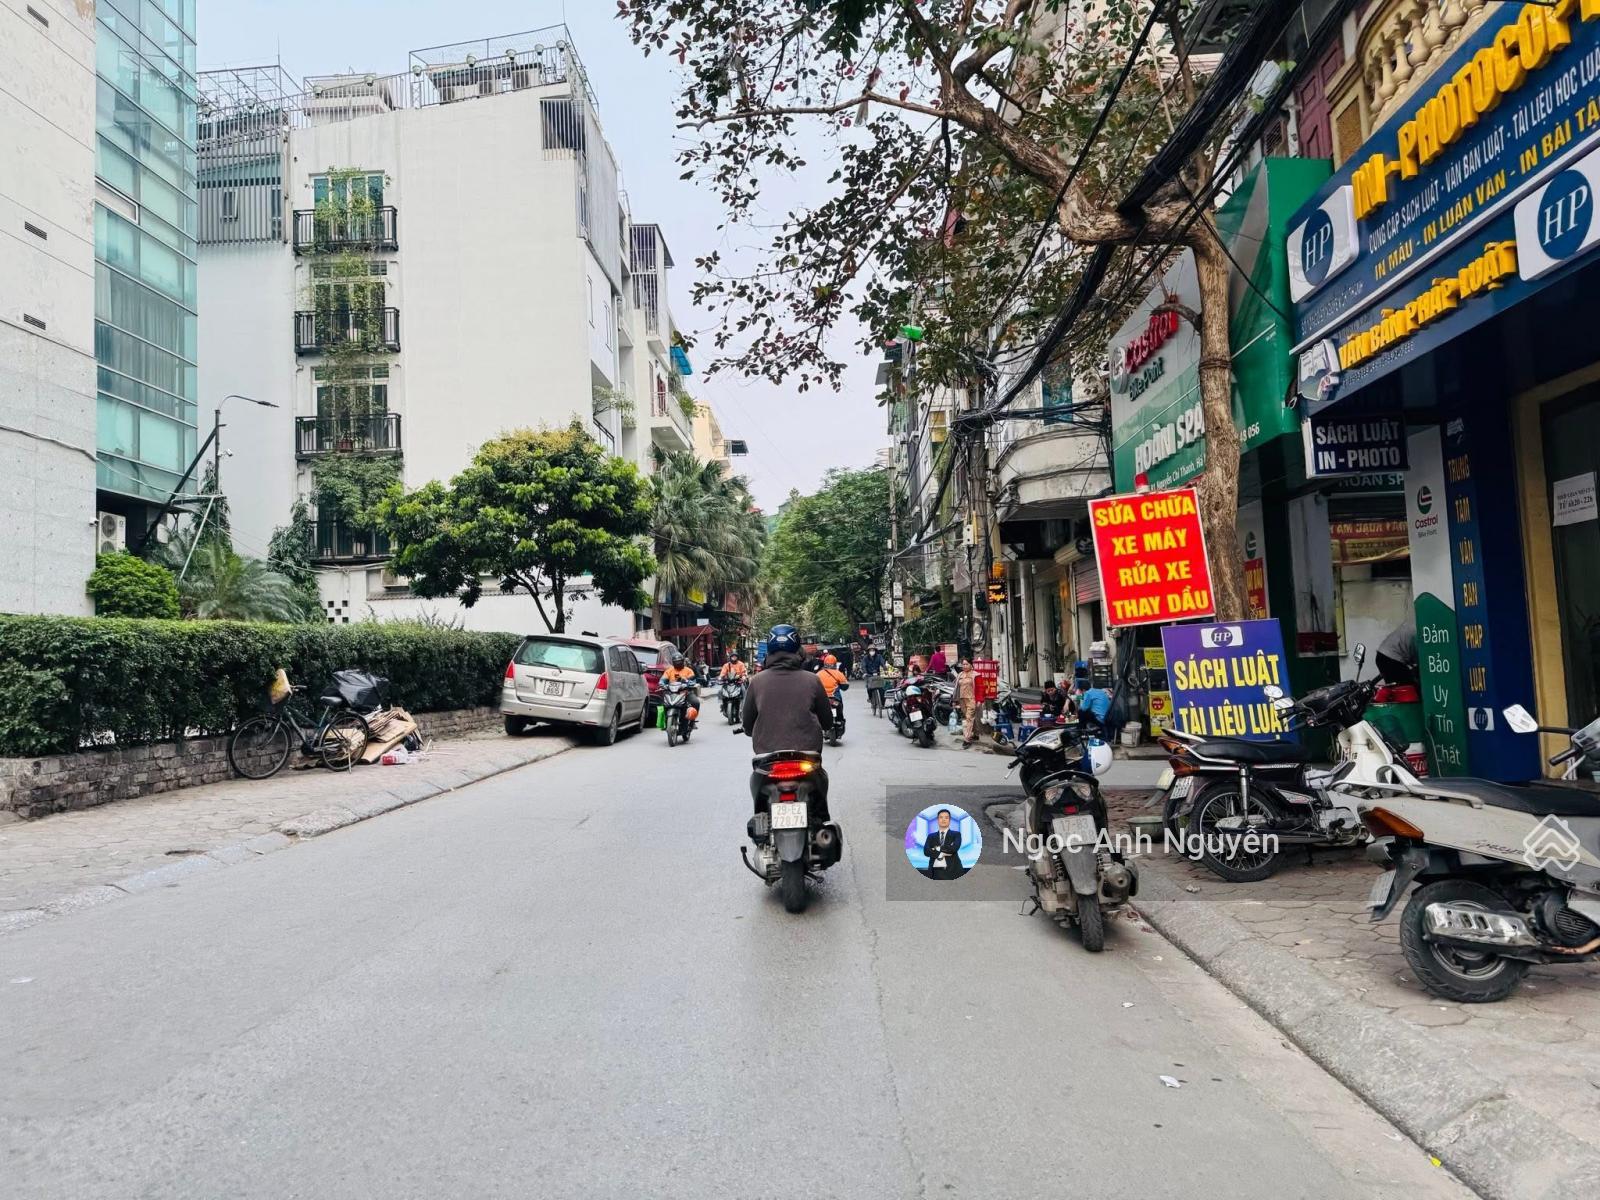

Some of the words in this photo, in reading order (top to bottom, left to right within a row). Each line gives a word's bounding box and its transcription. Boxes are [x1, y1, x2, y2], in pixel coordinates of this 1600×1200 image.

[1555, 66, 1578, 107] HỌC
[1375, 260, 1387, 281] IN
[1422, 220, 1438, 246] IN
[1440, 193, 1474, 234] LUẬN
[1519, 142, 1538, 175] IN
[1541, 118, 1572, 159] BÀI
[1575, 95, 1600, 132] TẬ
[1543, 184, 1588, 247] HP
[1304, 225, 1331, 272] HP
[1370, 308, 1409, 352] BẢN
[1405, 277, 1459, 332] PHÁP
[1458, 240, 1517, 299] LUẬT
[1134, 421, 1176, 474] HOÀN
[1316, 421, 1358, 446] SÁCH
[1361, 418, 1400, 445] LUẬT
[1318, 450, 1337, 470] IN
[1347, 446, 1401, 469] PHOTO
[1095, 500, 1136, 527] SỬA
[1141, 496, 1196, 520] CHỮA
[1414, 514, 1438, 529] Castrol
[1111, 535, 1138, 556] XE
[1143, 526, 1188, 552] MÁY
[1448, 453, 1470, 483] TRUNG
[1464, 621, 1483, 649] PHÁP
[1118, 560, 1161, 587] RỬA
[1164, 560, 1192, 581] XE
[1112, 599, 1163, 620] THAY
[1167, 586, 1209, 613] DẦU
[1212, 631, 1232, 643] HP
[1423, 624, 1449, 644] Đảm
[1173, 653, 1229, 691] SÁCH
[1428, 653, 1450, 673] Bảo
[1433, 684, 1449, 707] Uy
[1179, 700, 1207, 736] TÀI
[1435, 714, 1454, 734] Tín
